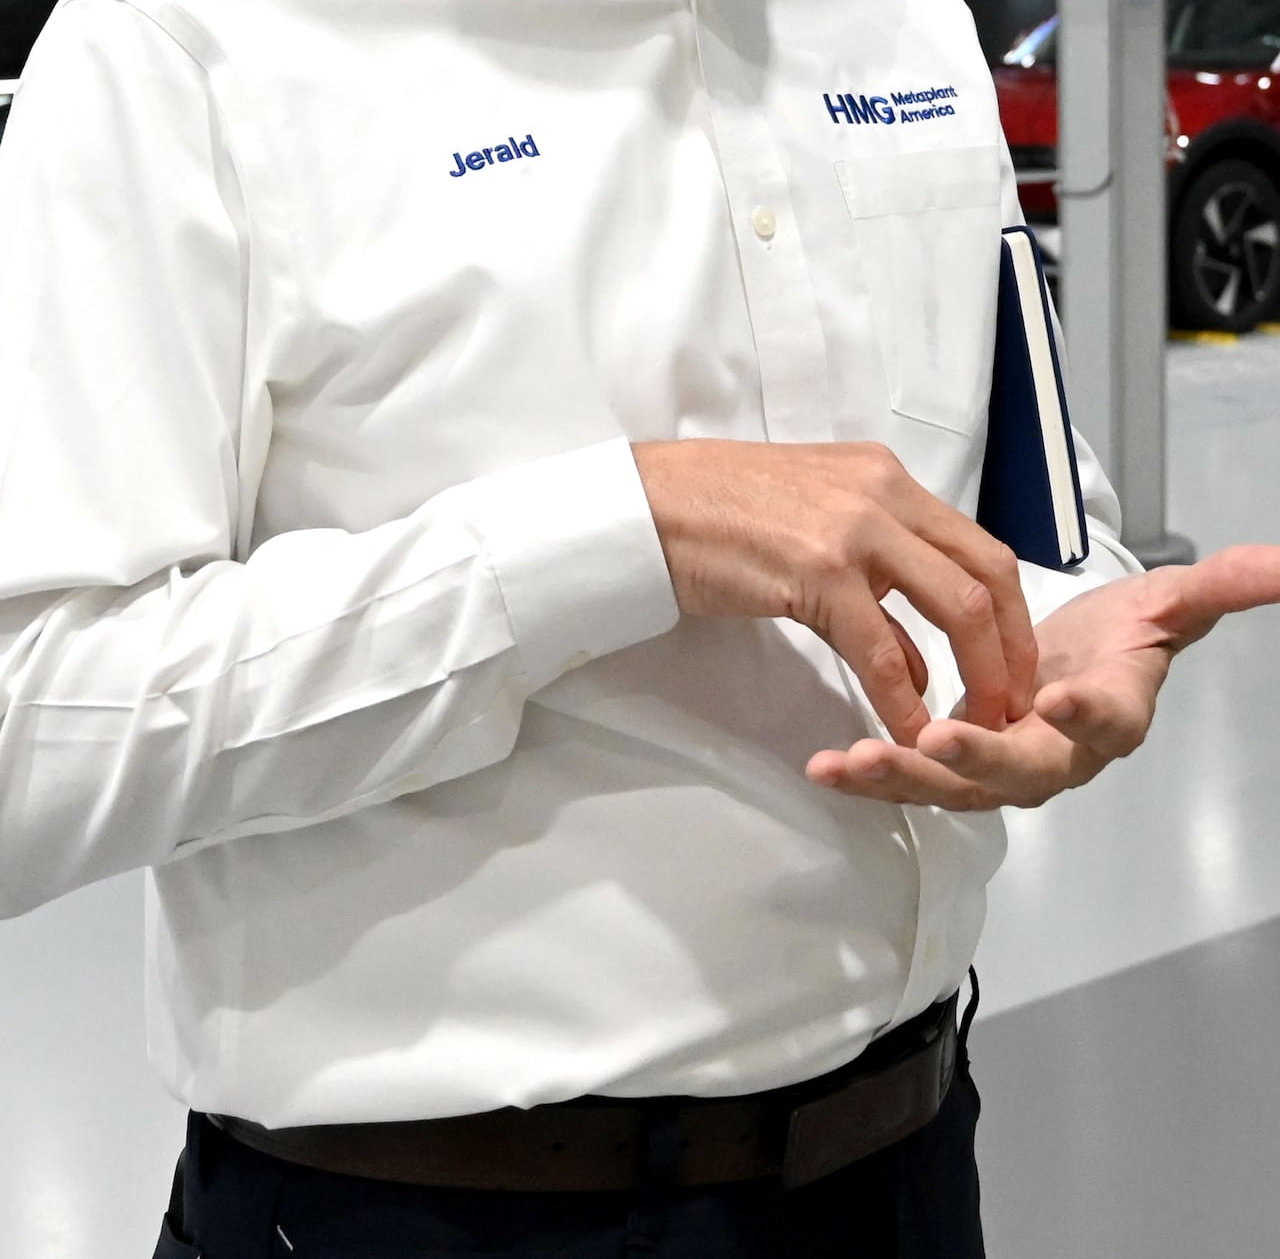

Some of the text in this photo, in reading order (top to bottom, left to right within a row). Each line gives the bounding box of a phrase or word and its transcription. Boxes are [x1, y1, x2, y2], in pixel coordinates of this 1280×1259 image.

[822, 93, 896, 125] HMG
[890, 85, 958, 107] Metaplant
[900, 104, 956, 124] America
[449, 134, 541, 178] Jerald
